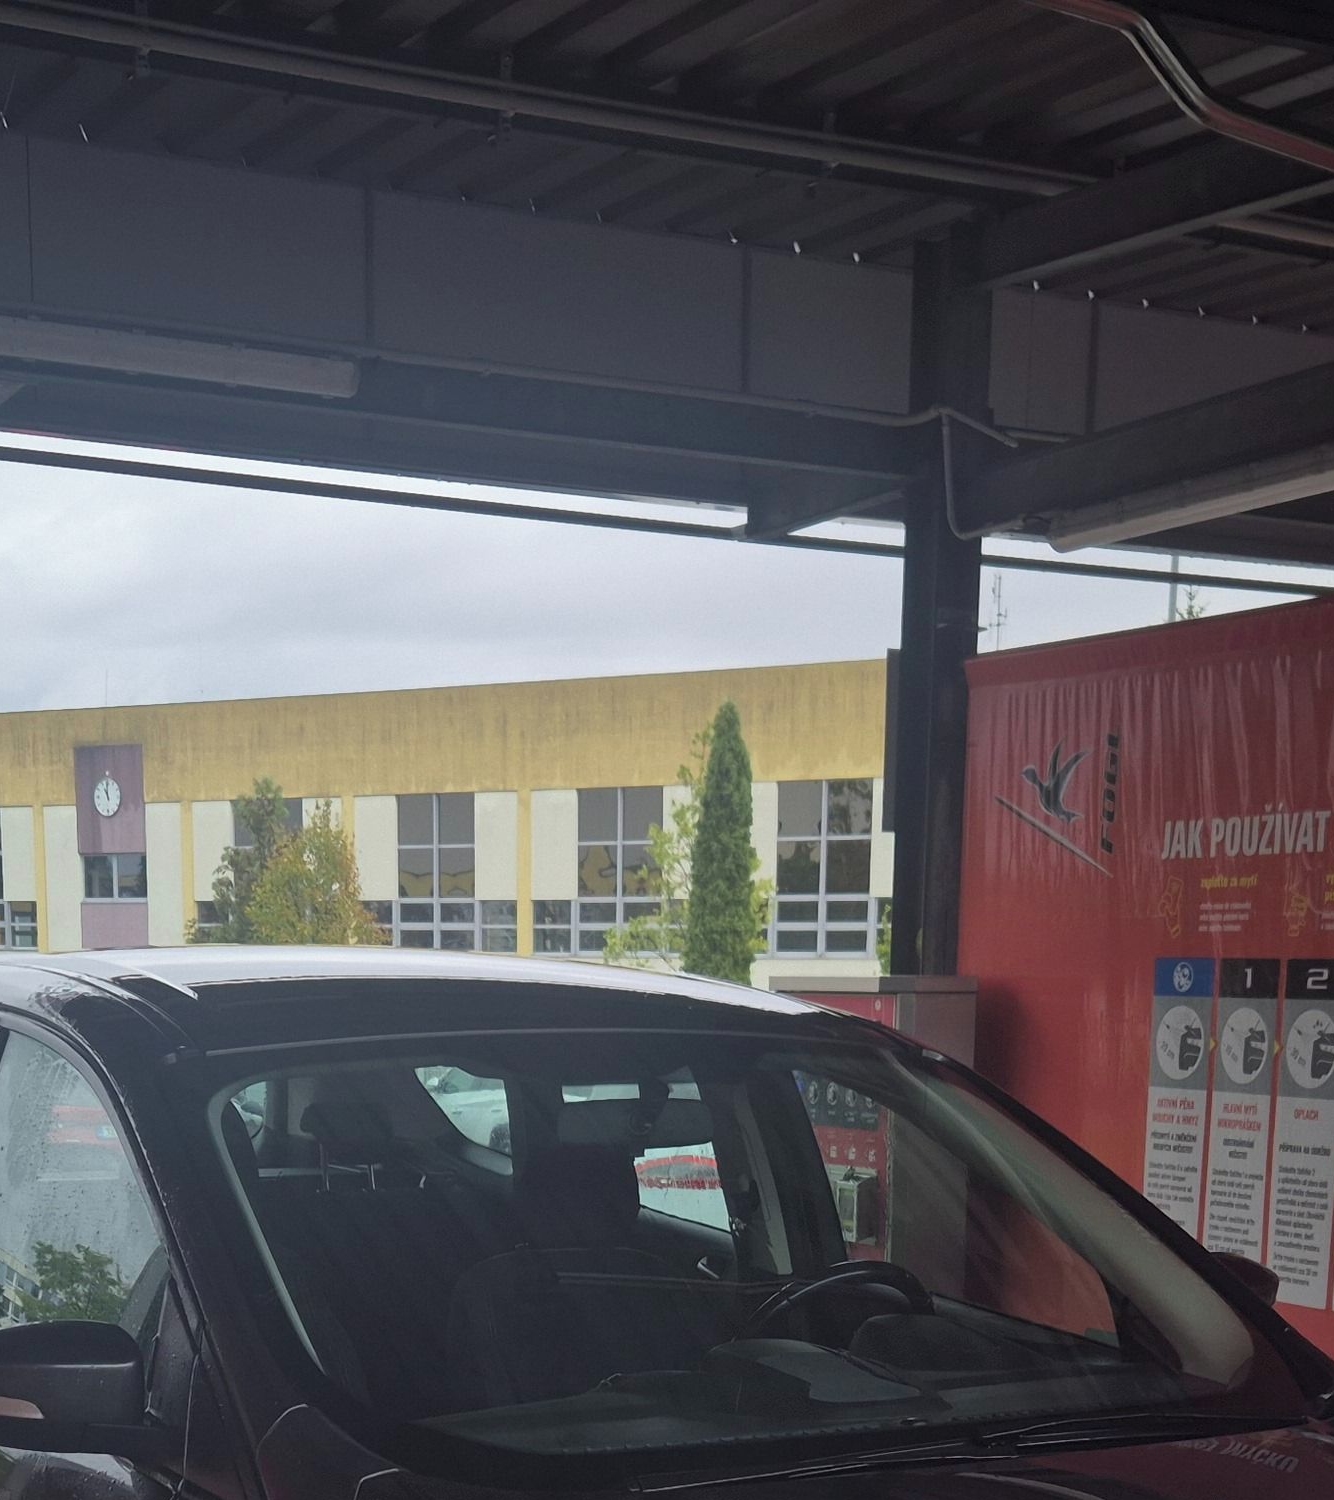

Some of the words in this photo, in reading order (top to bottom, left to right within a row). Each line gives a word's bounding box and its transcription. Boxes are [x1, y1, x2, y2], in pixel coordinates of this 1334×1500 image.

[1161, 819, 1204, 860] JAK
[1209, 803, 1332, 858] POUŽÍVAT
[1243, 968, 1254, 989] 1
[1306, 969, 1330, 990] 2
[1294, 1108, 1319, 1121] OPLACH
